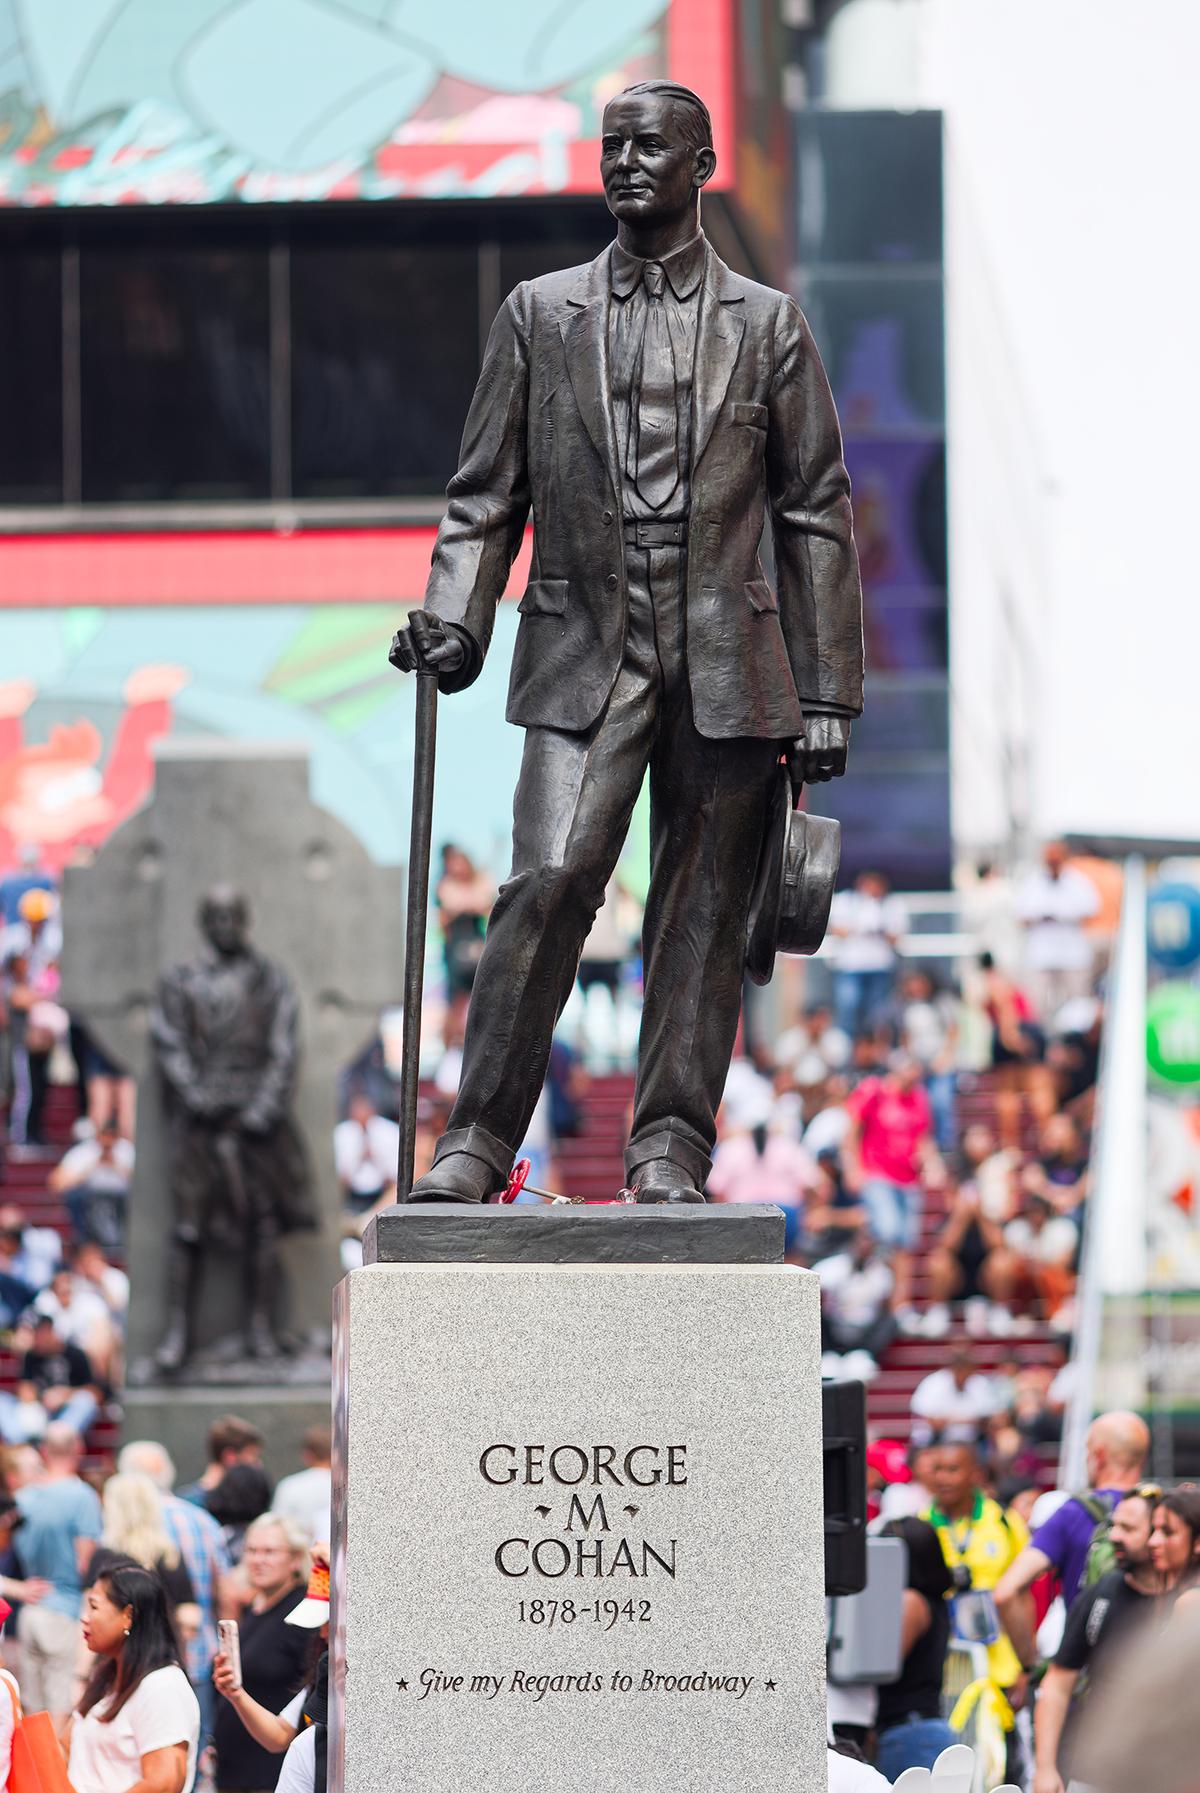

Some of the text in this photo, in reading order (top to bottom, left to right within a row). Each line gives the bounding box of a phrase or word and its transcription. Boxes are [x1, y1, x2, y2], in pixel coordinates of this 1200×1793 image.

[479, 1444, 688, 1487] GEORGE
[564, 1493, 611, 1532] M
[494, 1537, 677, 1579] COHAN
[517, 1599, 652, 1631] 1878-1942
[416, 1667, 755, 1702] Give my Regards to Broadway
